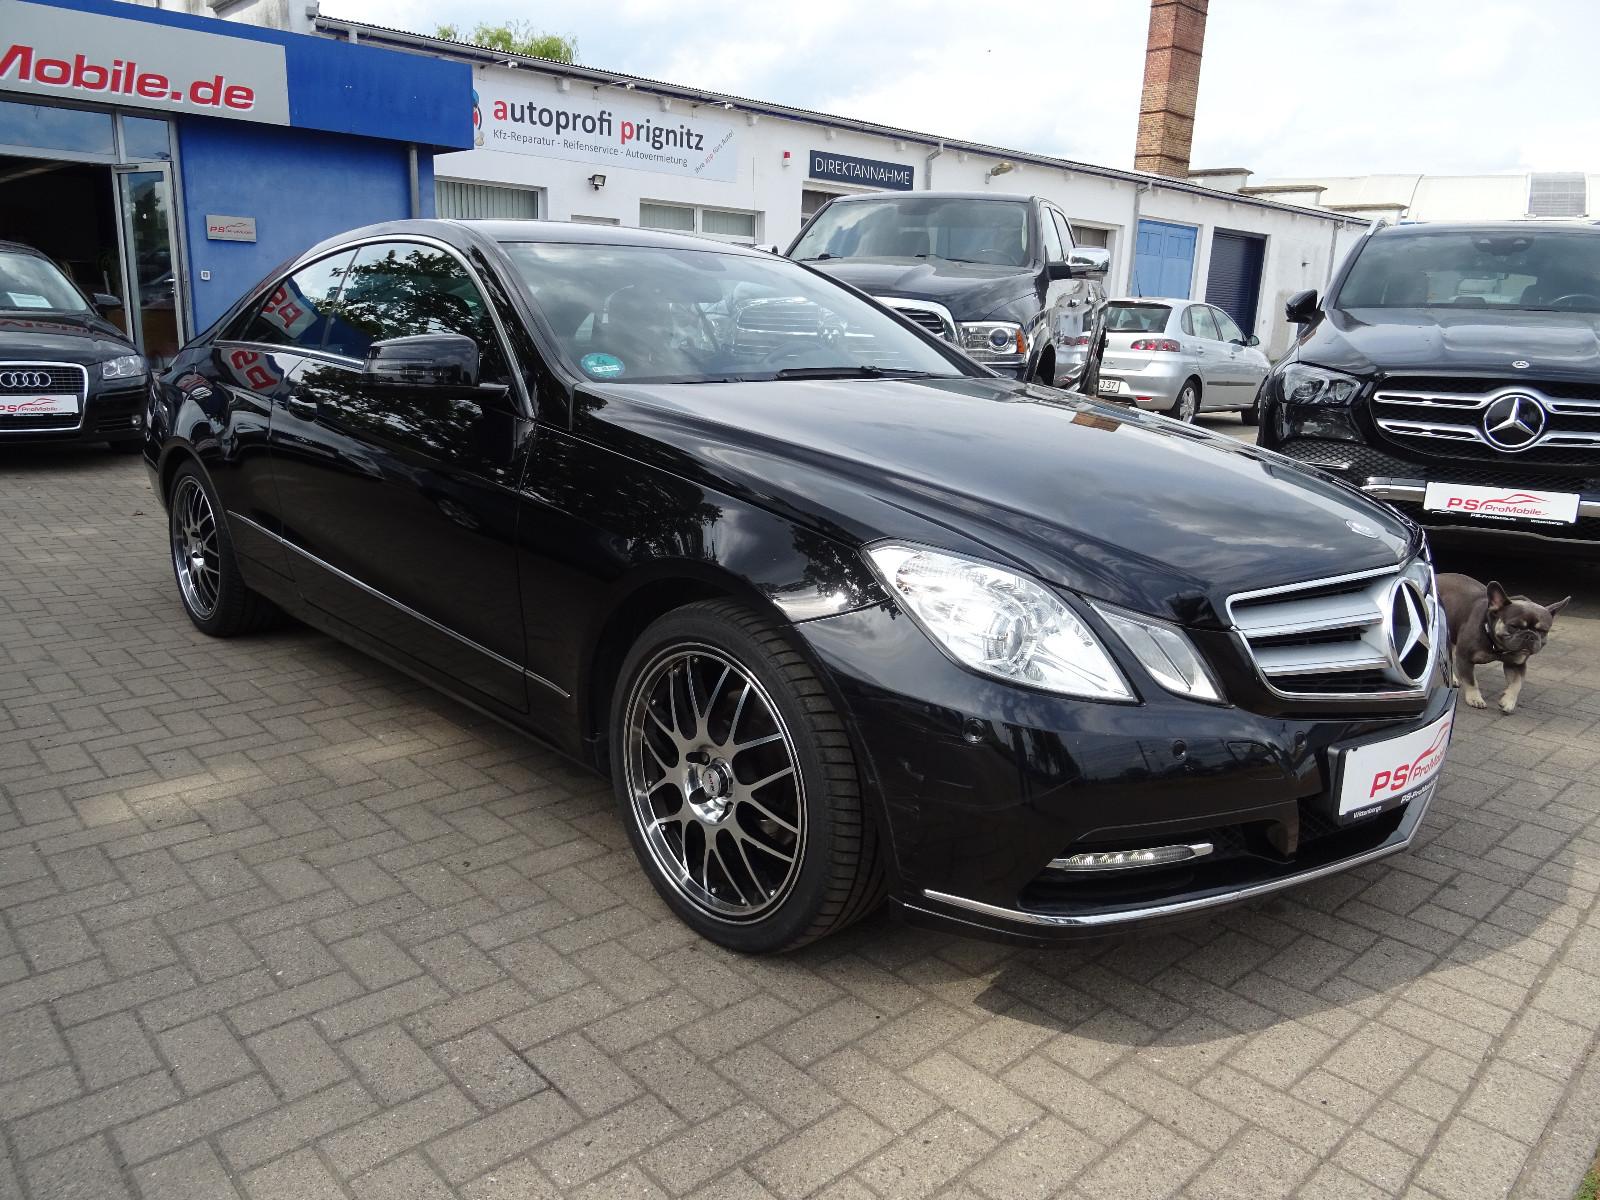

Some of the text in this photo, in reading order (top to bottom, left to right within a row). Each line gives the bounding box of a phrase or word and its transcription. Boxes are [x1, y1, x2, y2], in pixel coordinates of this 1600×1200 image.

[493, 100, 704, 151] autoprofi prignitz
[493, 129, 555, 147] Kfz-Reparatur
[563, 139, 619, 156] Reifenservice
[625, 148, 688, 168] Autovermietung
[815, 157, 910, 185] DIREKTANNAHME
[1105, 380, 1116, 389] 37
[1447, 497, 1543, 517] PS ProMobile
[1370, 764, 1410, 798] PS
